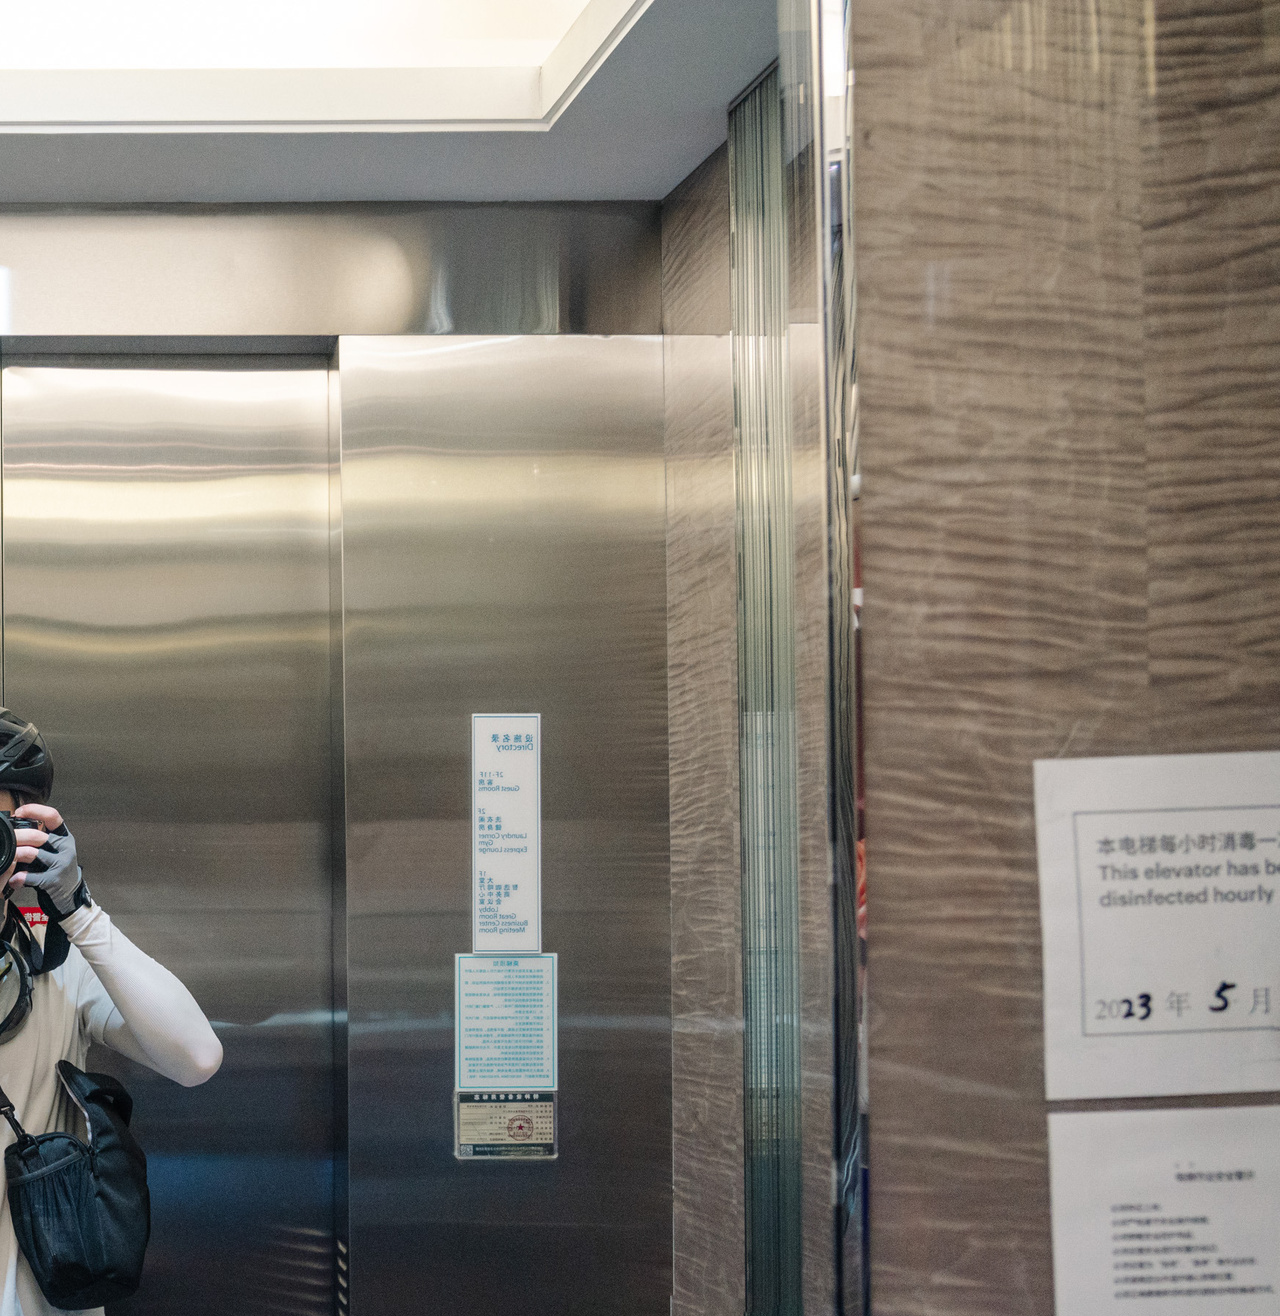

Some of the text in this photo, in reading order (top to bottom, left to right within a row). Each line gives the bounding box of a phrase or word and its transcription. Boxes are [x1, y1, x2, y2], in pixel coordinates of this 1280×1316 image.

[1097, 831, 1280, 855] 本电梯每小时消毒一
[1099, 864, 1138, 881] This
[1144, 861, 1221, 881] elevator
[1226, 860, 1259, 877] has
[1099, 885, 1274, 908] disinfected hourly
[1209, 982, 1236, 1013] 5
[1249, 987, 1271, 1015] 月
